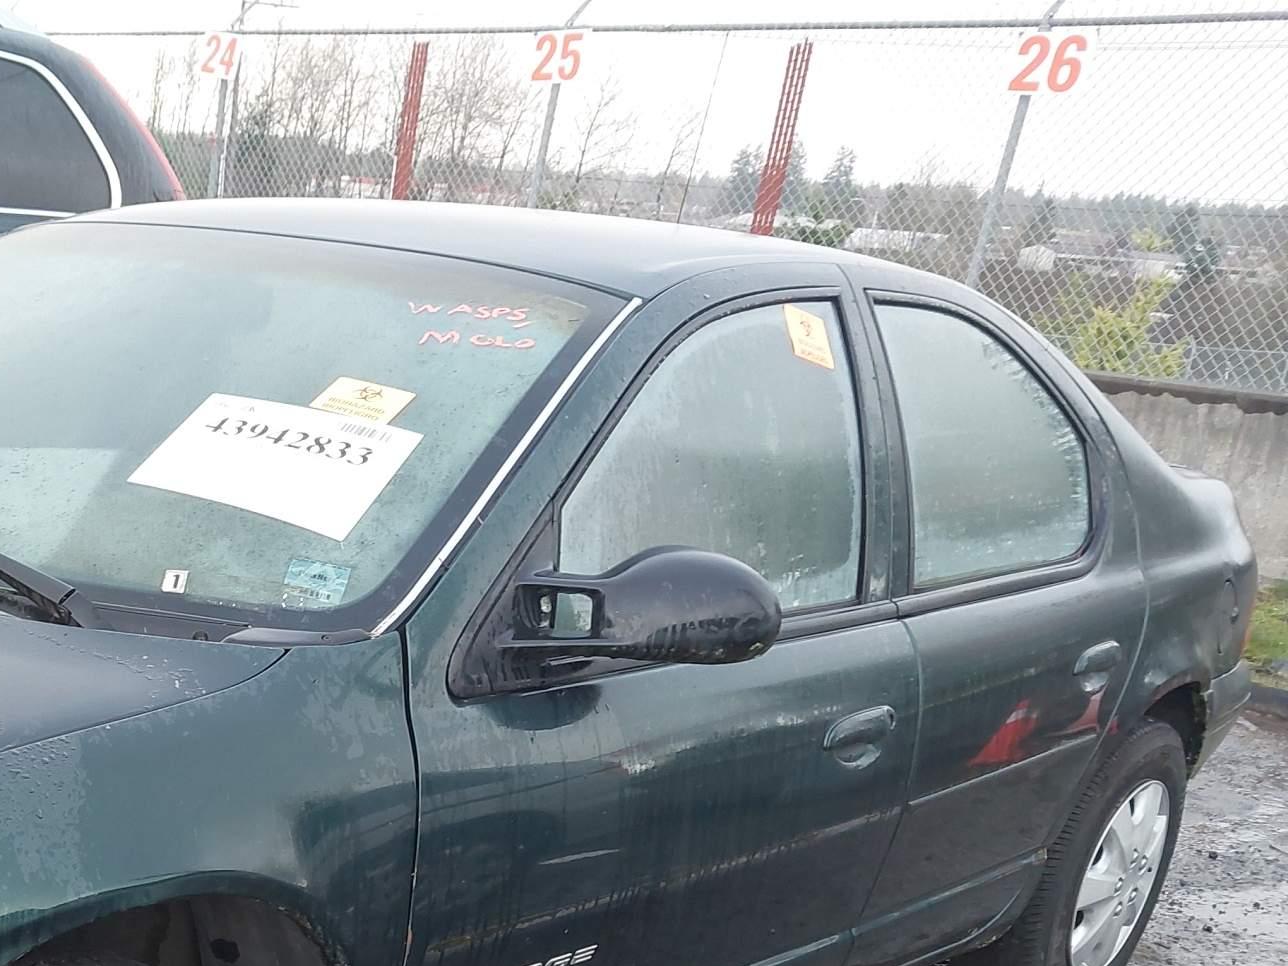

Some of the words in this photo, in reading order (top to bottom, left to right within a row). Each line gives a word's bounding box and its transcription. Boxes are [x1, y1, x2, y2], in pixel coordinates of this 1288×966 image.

[201, 34, 238, 76] 24
[531, 32, 584, 81] 25
[1007, 34, 1088, 93] 26
[205, 416, 373, 466] 43942833
[172, 573, 181, 589] 1
